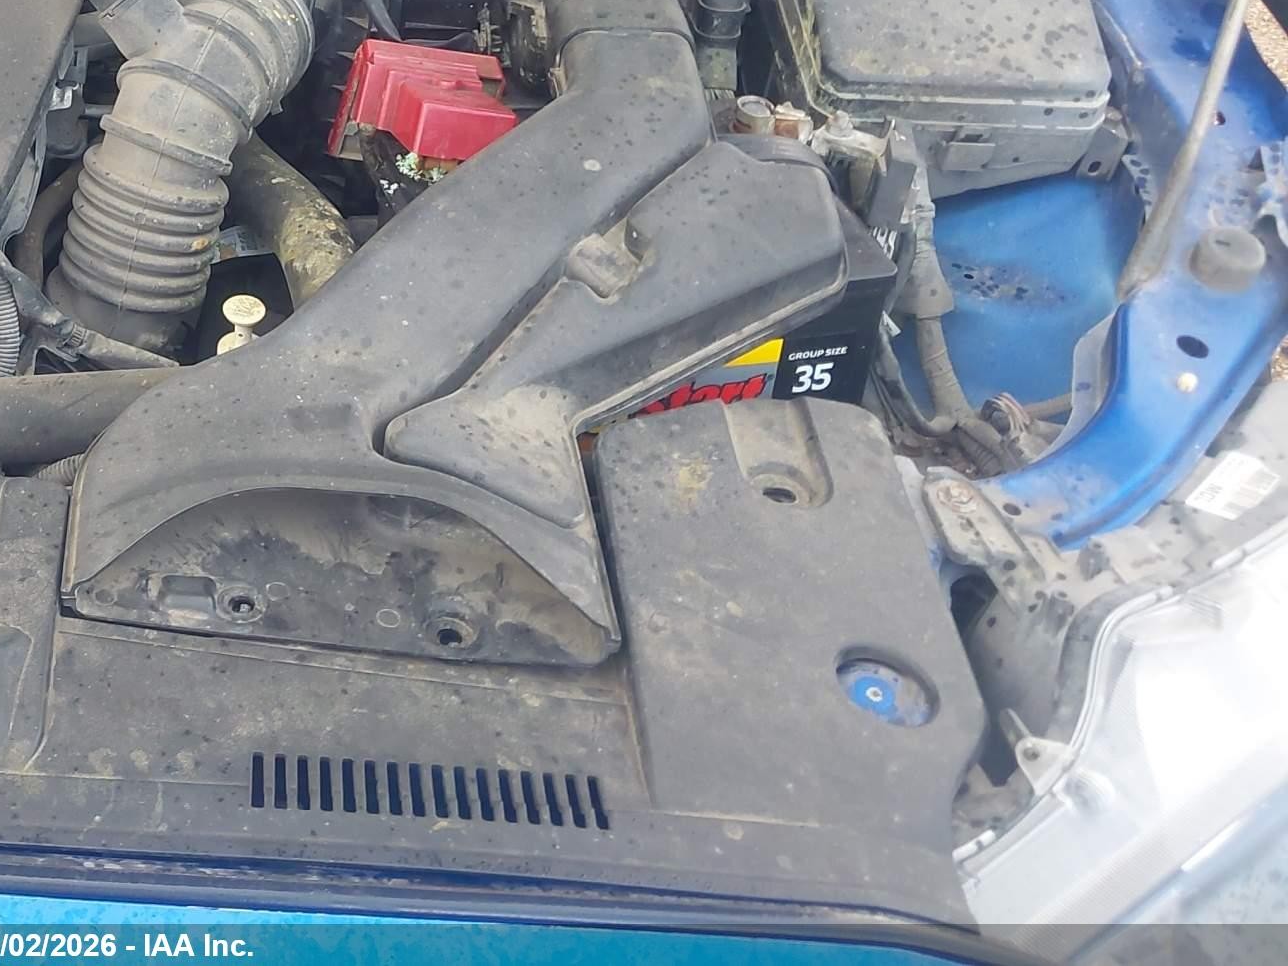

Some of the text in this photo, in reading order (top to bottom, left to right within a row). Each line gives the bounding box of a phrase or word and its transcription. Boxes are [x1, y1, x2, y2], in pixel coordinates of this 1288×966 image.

[788, 346, 848, 361] GROUP SIZE
[791, 362, 834, 394] 35
